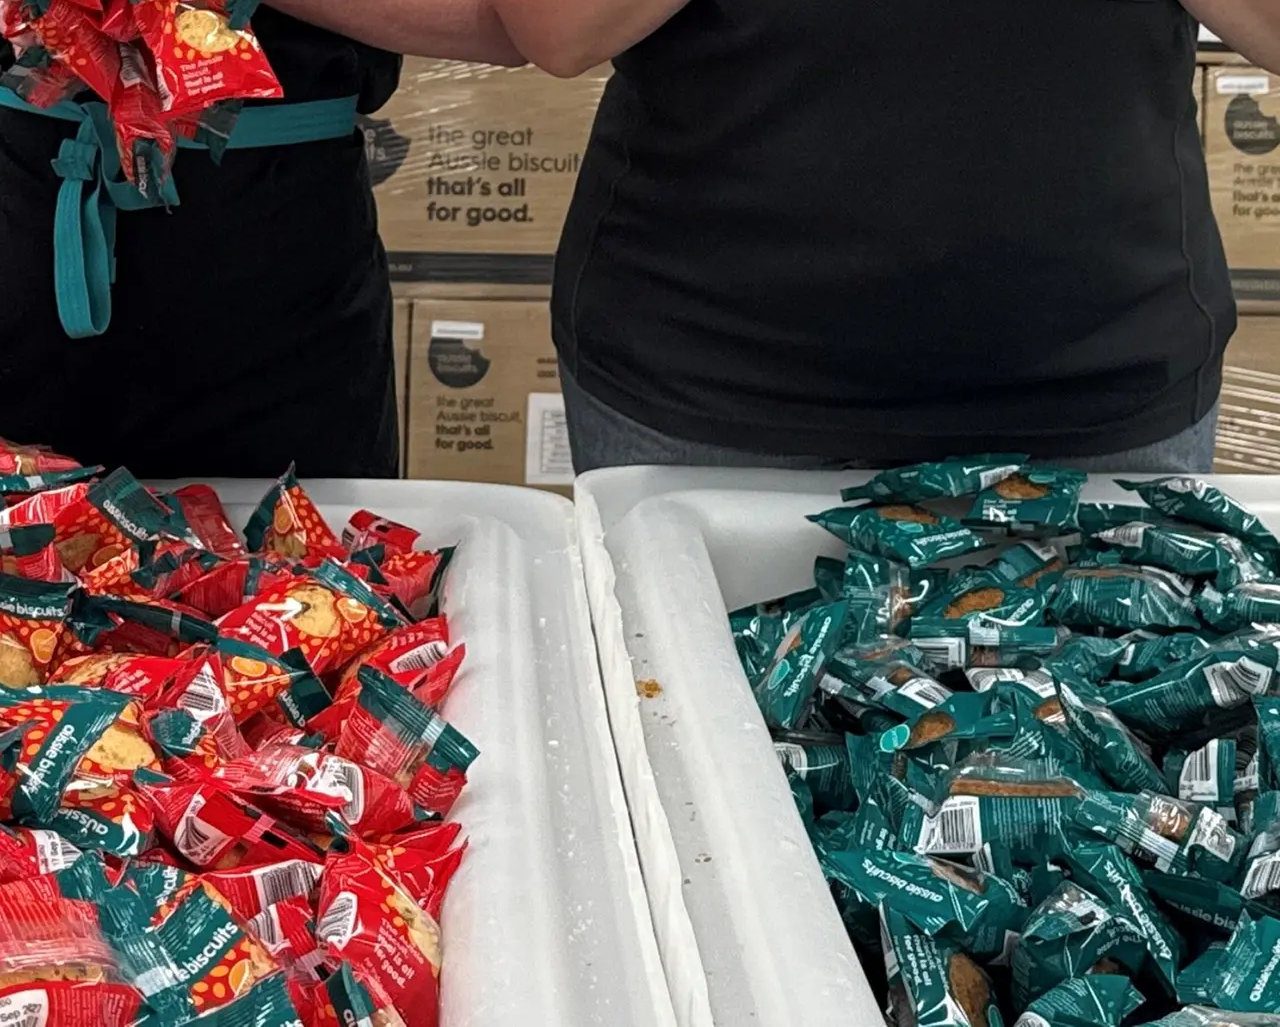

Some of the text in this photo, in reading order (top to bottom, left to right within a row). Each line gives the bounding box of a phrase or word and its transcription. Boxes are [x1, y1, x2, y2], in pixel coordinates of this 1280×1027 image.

[427, 125, 535, 150] the great
[427, 152, 501, 172] Aussie
[427, 177, 526, 197] that's all
[427, 203, 535, 226] for good.
[1233, 204, 1252, 216] for
[460, 396, 495, 410] great
[435, 424, 491, 435] that's all
[435, 438, 494, 452] for good.
[188, 920, 239, 976] biscuits
